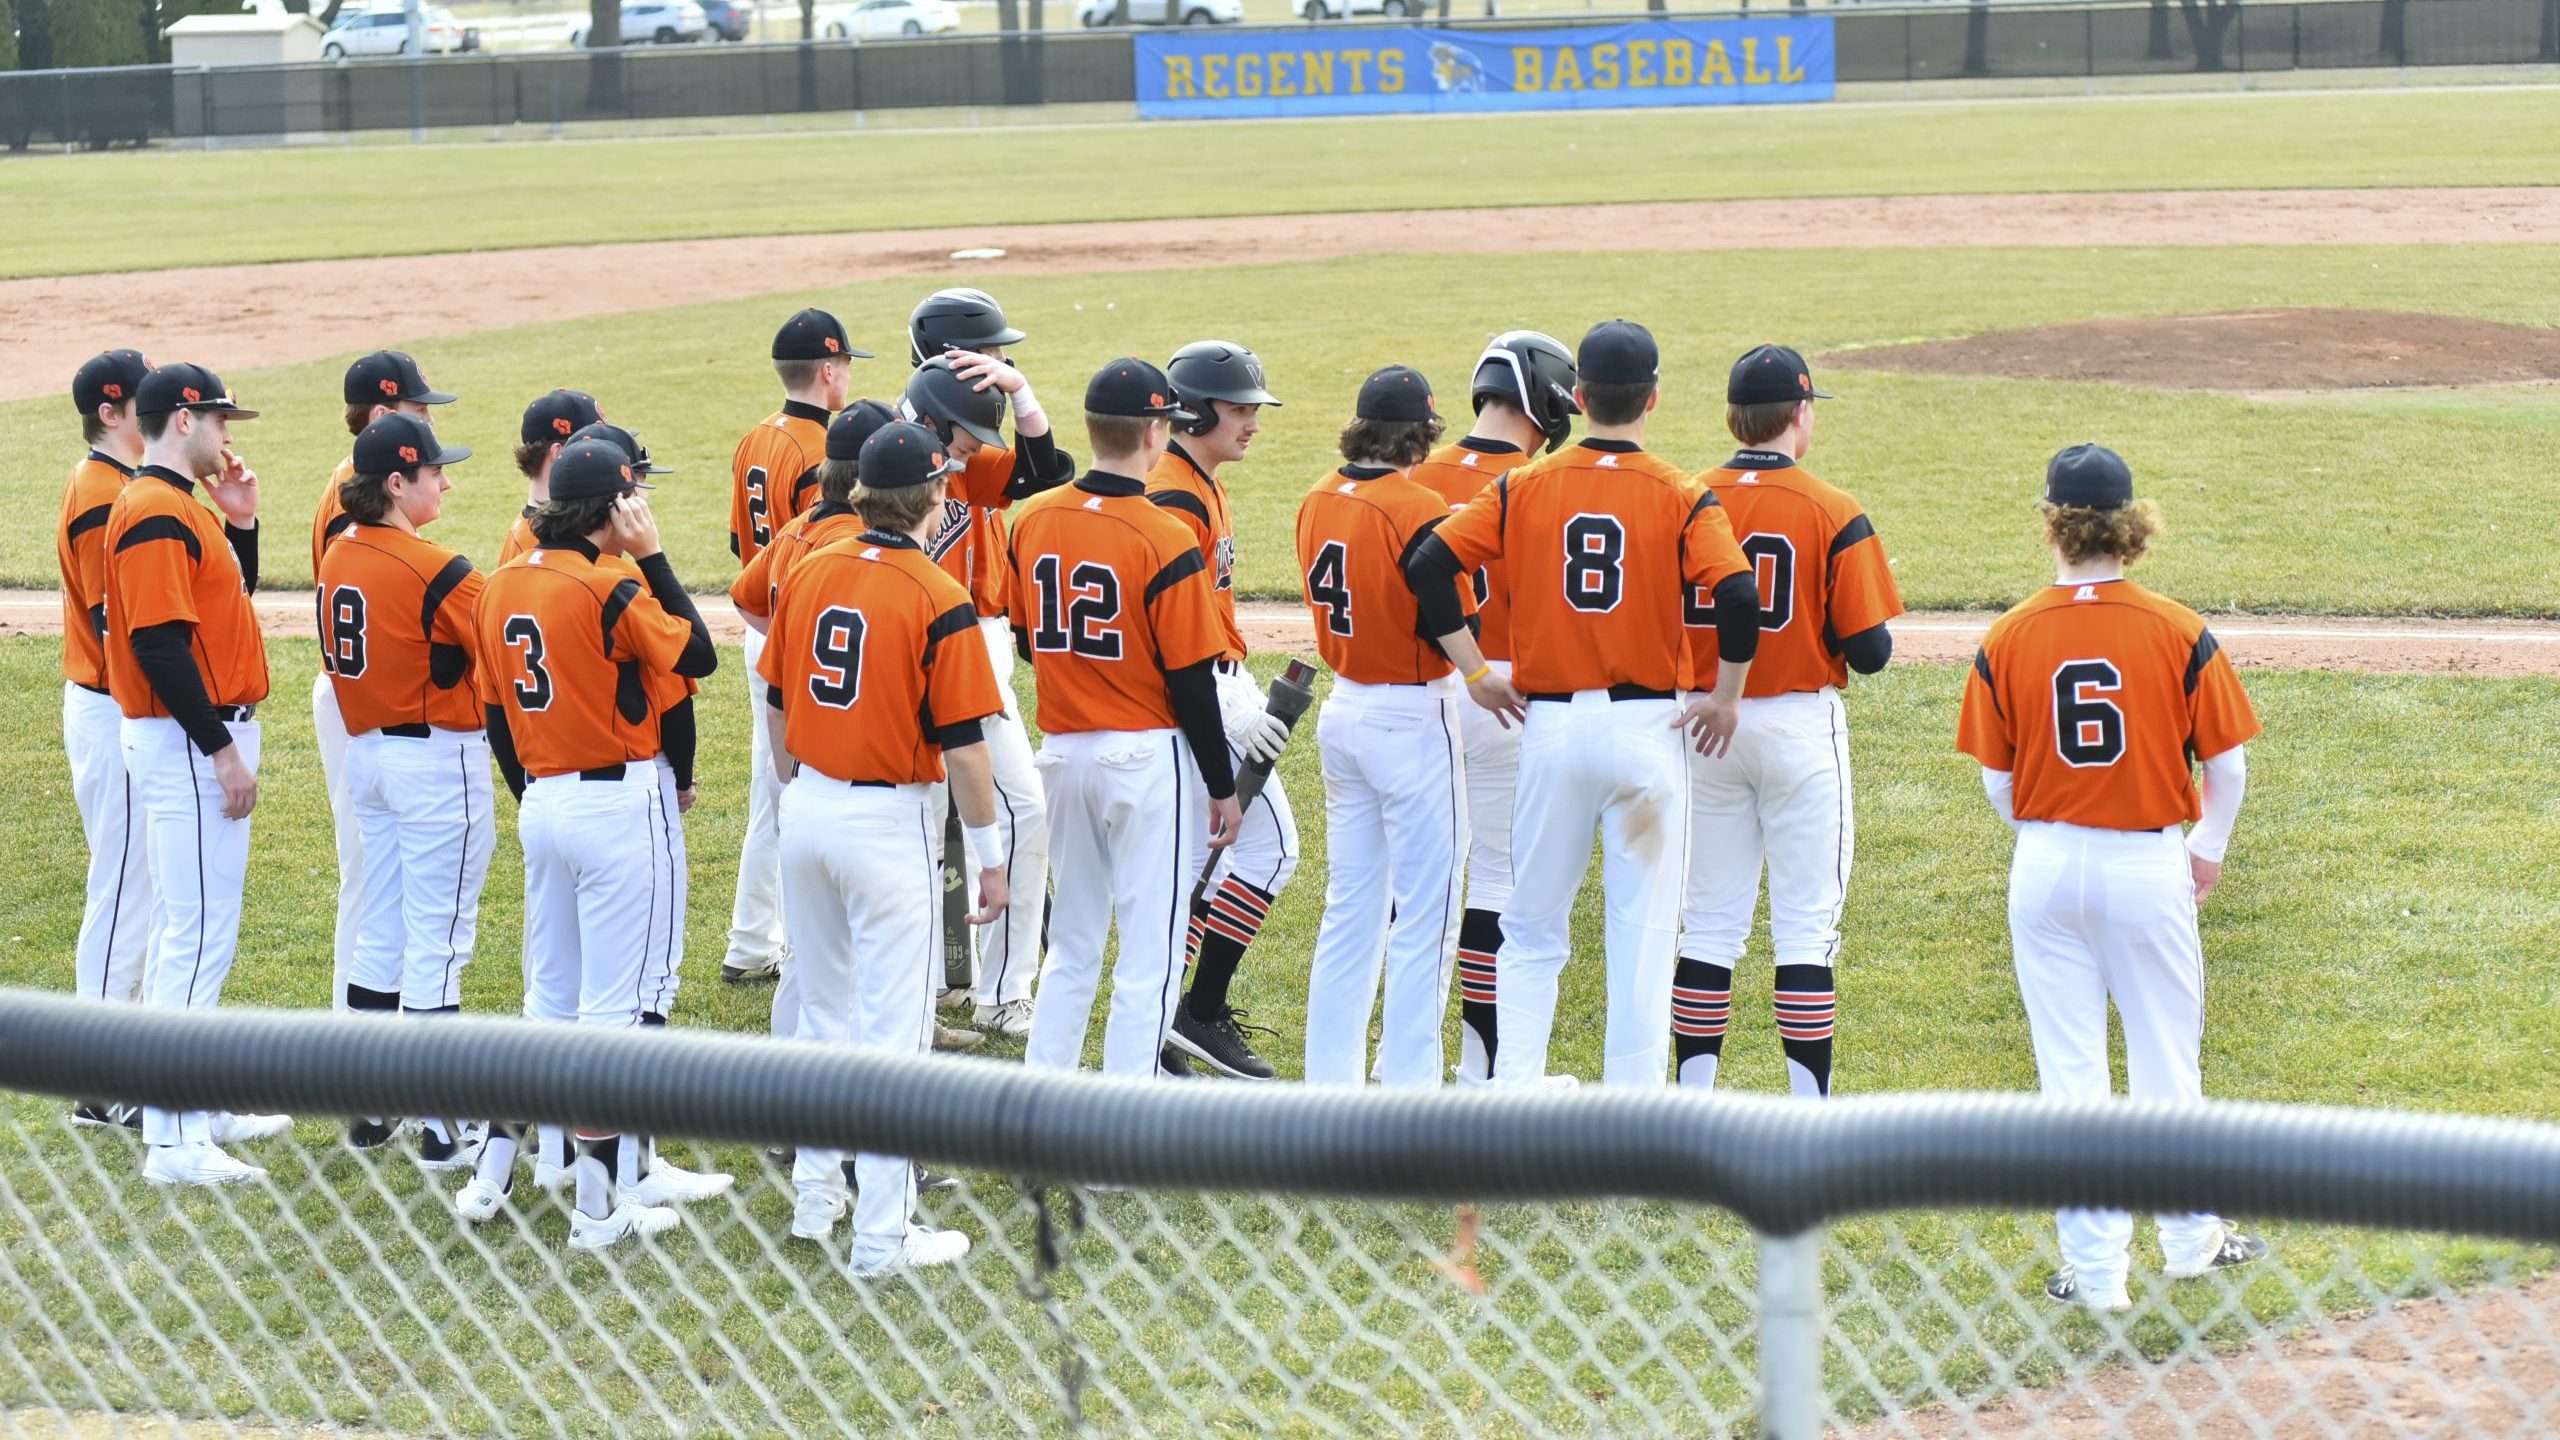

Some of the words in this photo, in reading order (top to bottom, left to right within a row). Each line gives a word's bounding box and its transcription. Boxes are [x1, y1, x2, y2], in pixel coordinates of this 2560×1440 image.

[1164, 48, 1405, 98] REGENTS
[1512, 36, 1806, 92] BASEBALL
[746, 465, 772, 549] 2
[1032, 553, 1124, 661] 12
[1307, 540, 1354, 637] 4
[1564, 512, 1625, 613] 8
[503, 614, 553, 712] 3
[808, 604, 868, 710] 9
[2052, 658, 2126, 768] 6
